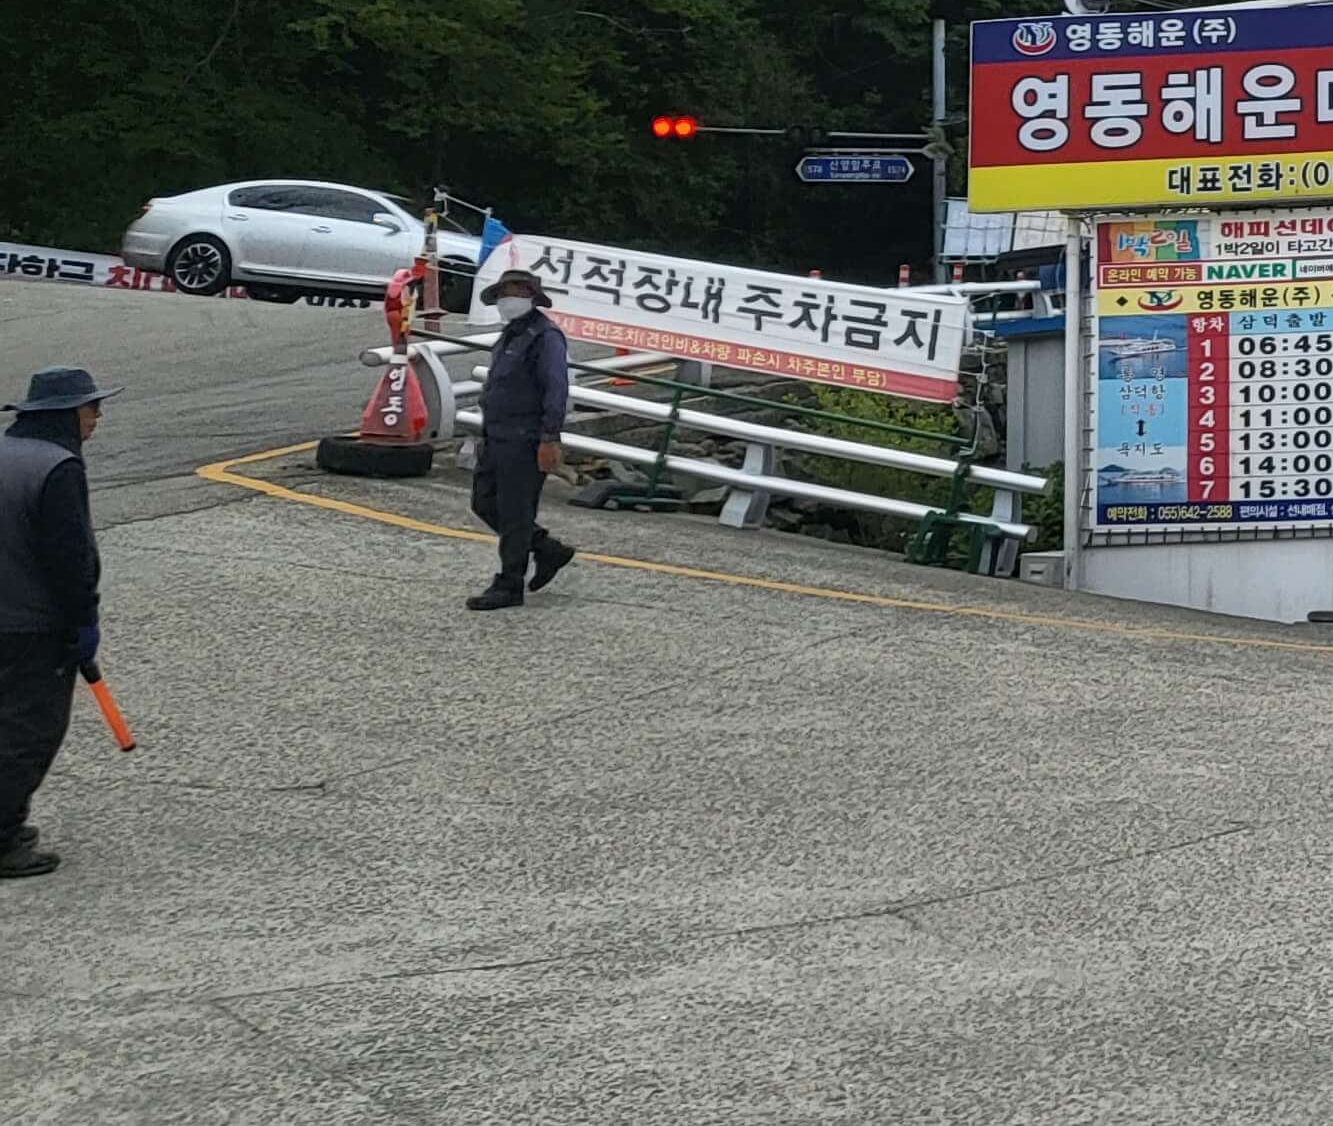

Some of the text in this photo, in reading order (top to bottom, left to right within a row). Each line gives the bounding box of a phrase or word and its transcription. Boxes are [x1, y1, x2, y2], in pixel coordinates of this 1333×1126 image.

[1065, 17, 1237, 52] 영동해운(주)
[1215, 240, 1280, 256] 1박2일이
[1107, 266, 1197, 282] 온라인 예약 가능
[1207, 262, 1287, 280] NAVER
[529, 247, 943, 361] 선적장내 주차금지
[1197, 285, 1321, 311] 영동해운(주)
[1191, 317, 1225, 334] 항차
[1200, 339, 1212, 357] 1
[1238, 334, 1333, 355] 06:45
[1199, 363, 1215, 381] 2
[1238, 358, 1333, 379] 08:30
[1199, 386, 1216, 404] 3
[1239, 382, 1332, 403] 10:00
[1199, 410, 1216, 428] 4
[1239, 406, 1332, 427] 11:00
[1117, 442, 1164, 457] 욕지도
[1199, 433, 1216, 452] 5
[1239, 430, 1332, 451] 13:00
[1199, 456, 1216, 475] 6
[1239, 454, 1332, 475] 14:00
[1199, 480, 1215, 499] 7
[1239, 478, 1332, 499] 15:30
[1106, 506, 1147, 521] 예약전화
